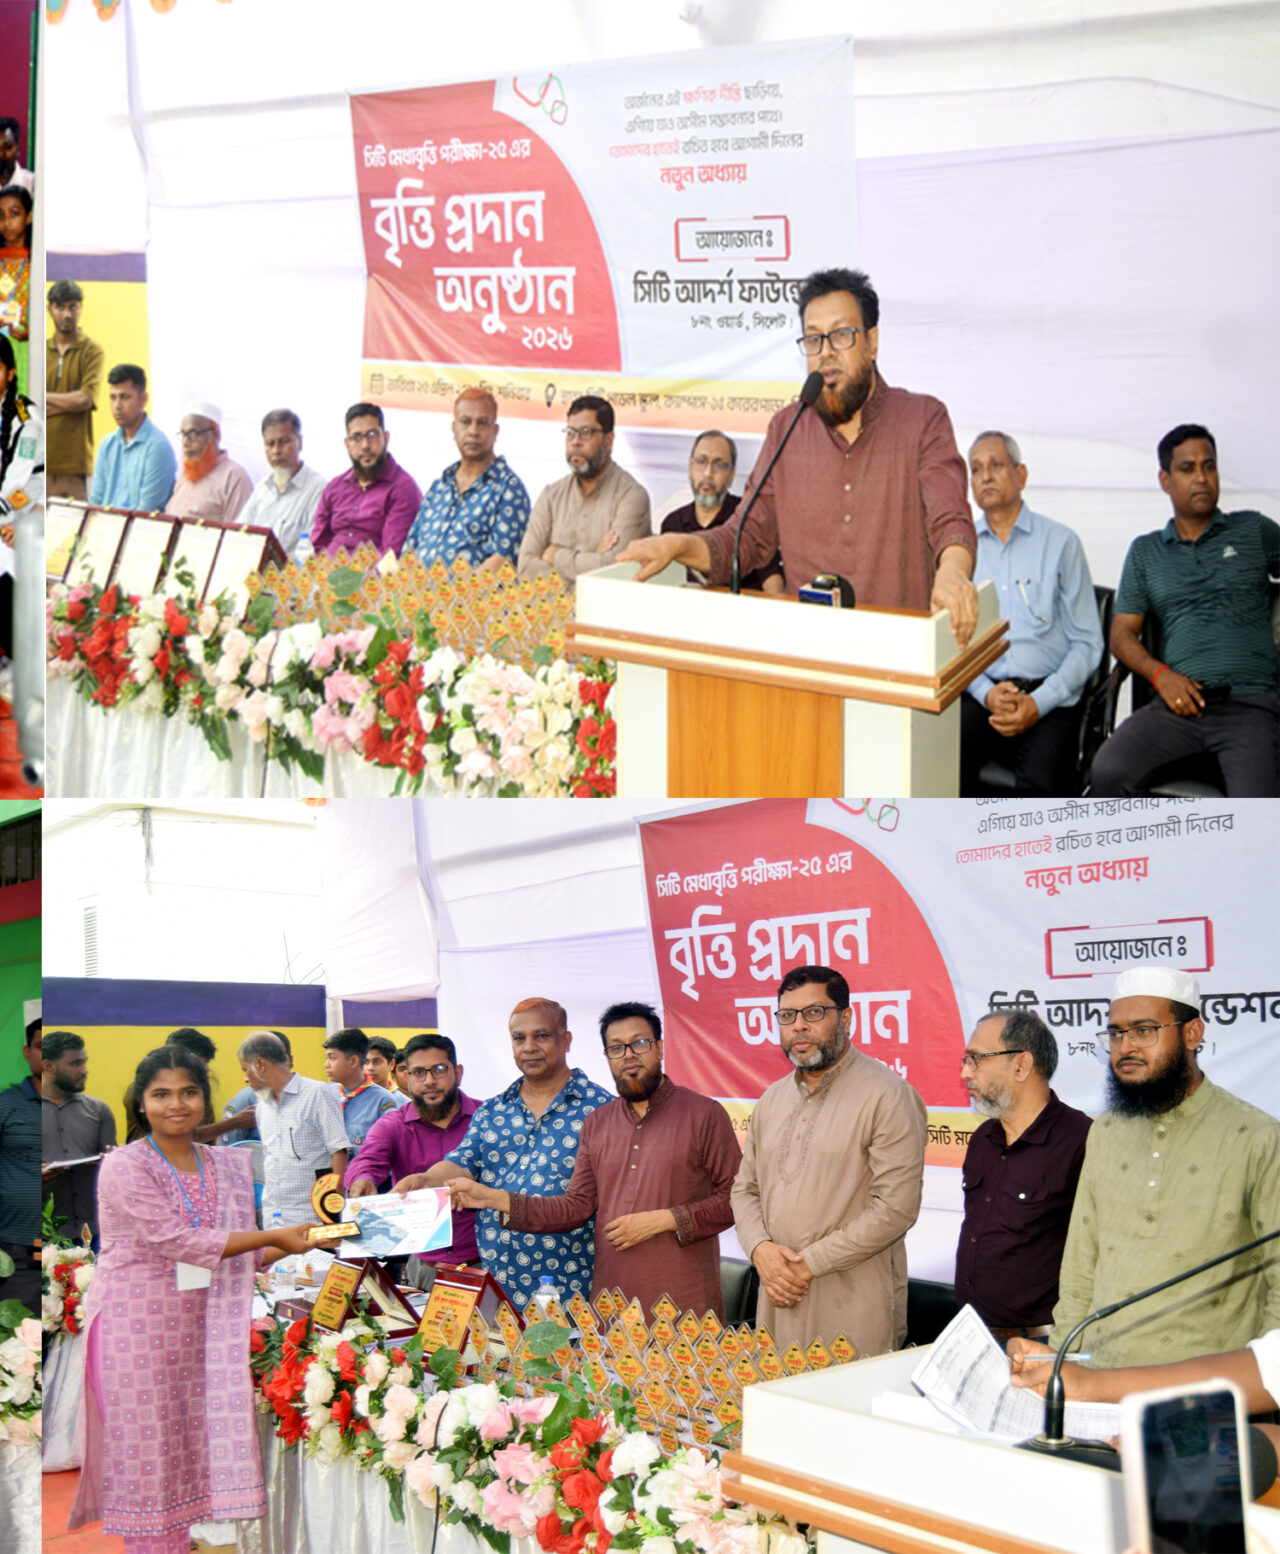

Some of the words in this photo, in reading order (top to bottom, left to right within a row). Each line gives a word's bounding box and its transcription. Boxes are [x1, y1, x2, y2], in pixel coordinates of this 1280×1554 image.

[509, 138, 531, 158] এর
[660, 166, 694, 191] নতুন
[698, 163, 748, 184] অধ্যায়
[370, 178, 435, 268] বৃত্তি
[444, 191, 546, 252] প্রদান
[433, 247, 576, 334] অনুষ্ঠান
[633, 270, 671, 304] সিটি
[674, 268, 734, 304] আদর্শ
[521, 326, 573, 350] ২০২৬
[977, 812, 1016, 835] এগিয়ে
[1019, 811, 1044, 828] যাও
[1048, 800, 1089, 824] অসীম
[955, 843, 1011, 864] তোমাদের
[1014, 834, 1053, 857] হাতেই
[1056, 829, 1092, 853] রচিত
[1096, 828, 1122, 847] হবে
[1126, 815, 1182, 843] আগামী
[1185, 813, 1235, 835] দিনের
[656, 872, 681, 898] সিটি
[683, 863, 738, 896] মেধাবৃত্তি
[741, 856, 822, 886] পরীক্ষা-২৫
[826, 851, 853, 873] এর
[1024, 865, 1073, 897] নতুন
[1077, 856, 1149, 884] অধ্যায়
[664, 904, 736, 1001] বৃত্তি
[747, 907, 871, 981] প্রদান
[1067, 1041, 1096, 1058] ৮নং
